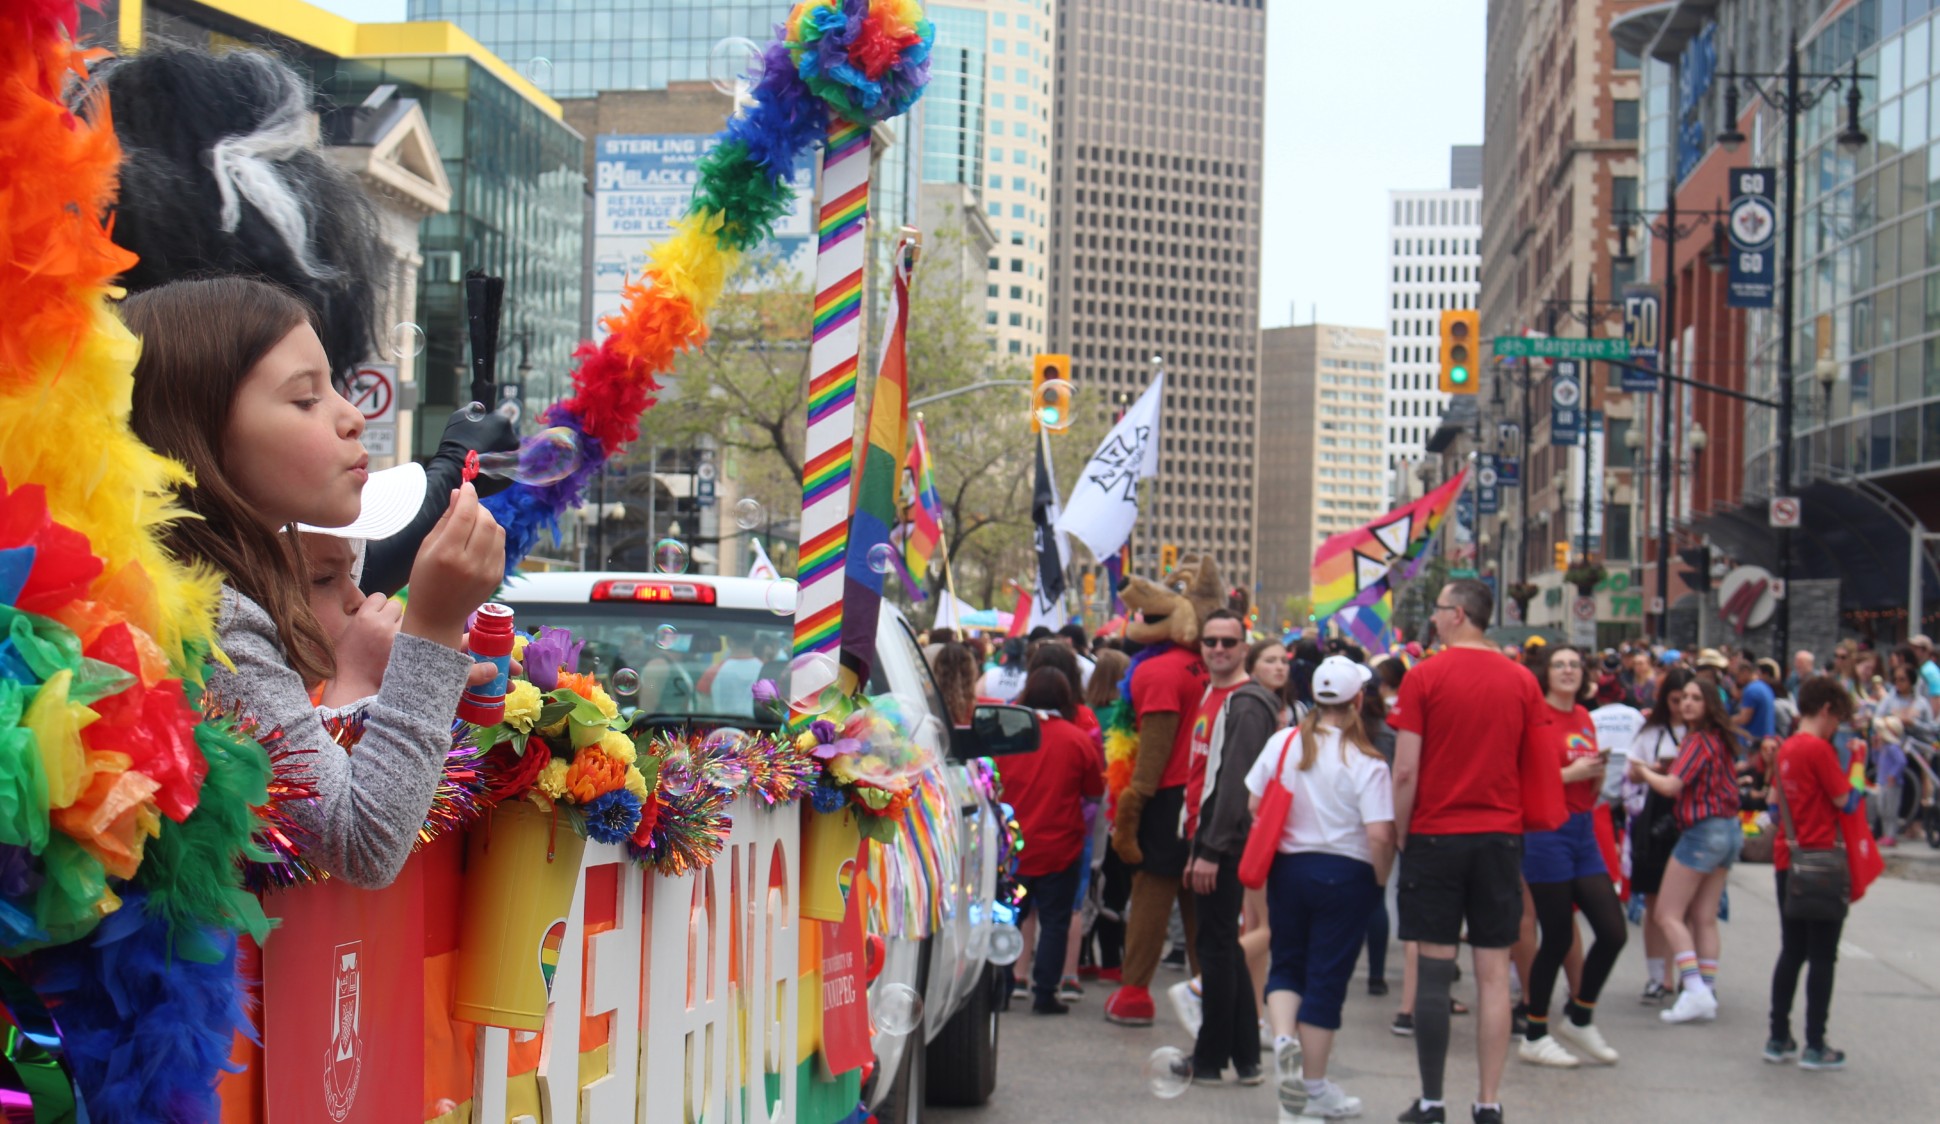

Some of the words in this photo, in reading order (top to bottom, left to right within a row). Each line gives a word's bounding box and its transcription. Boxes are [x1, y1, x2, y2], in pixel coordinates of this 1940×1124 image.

[606, 140, 696, 154] STERLING
[1740, 173, 1764, 194] GO
[607, 195, 656, 206] RETAIL
[607, 208, 671, 217] PORTAGE
[613, 220, 641, 230] FOR
[1739, 252, 1763, 273] GO
[1626, 297, 1658, 348] 50
[1535, 341, 1605, 357] Hargrave
[1610, 341, 1626, 355] St
